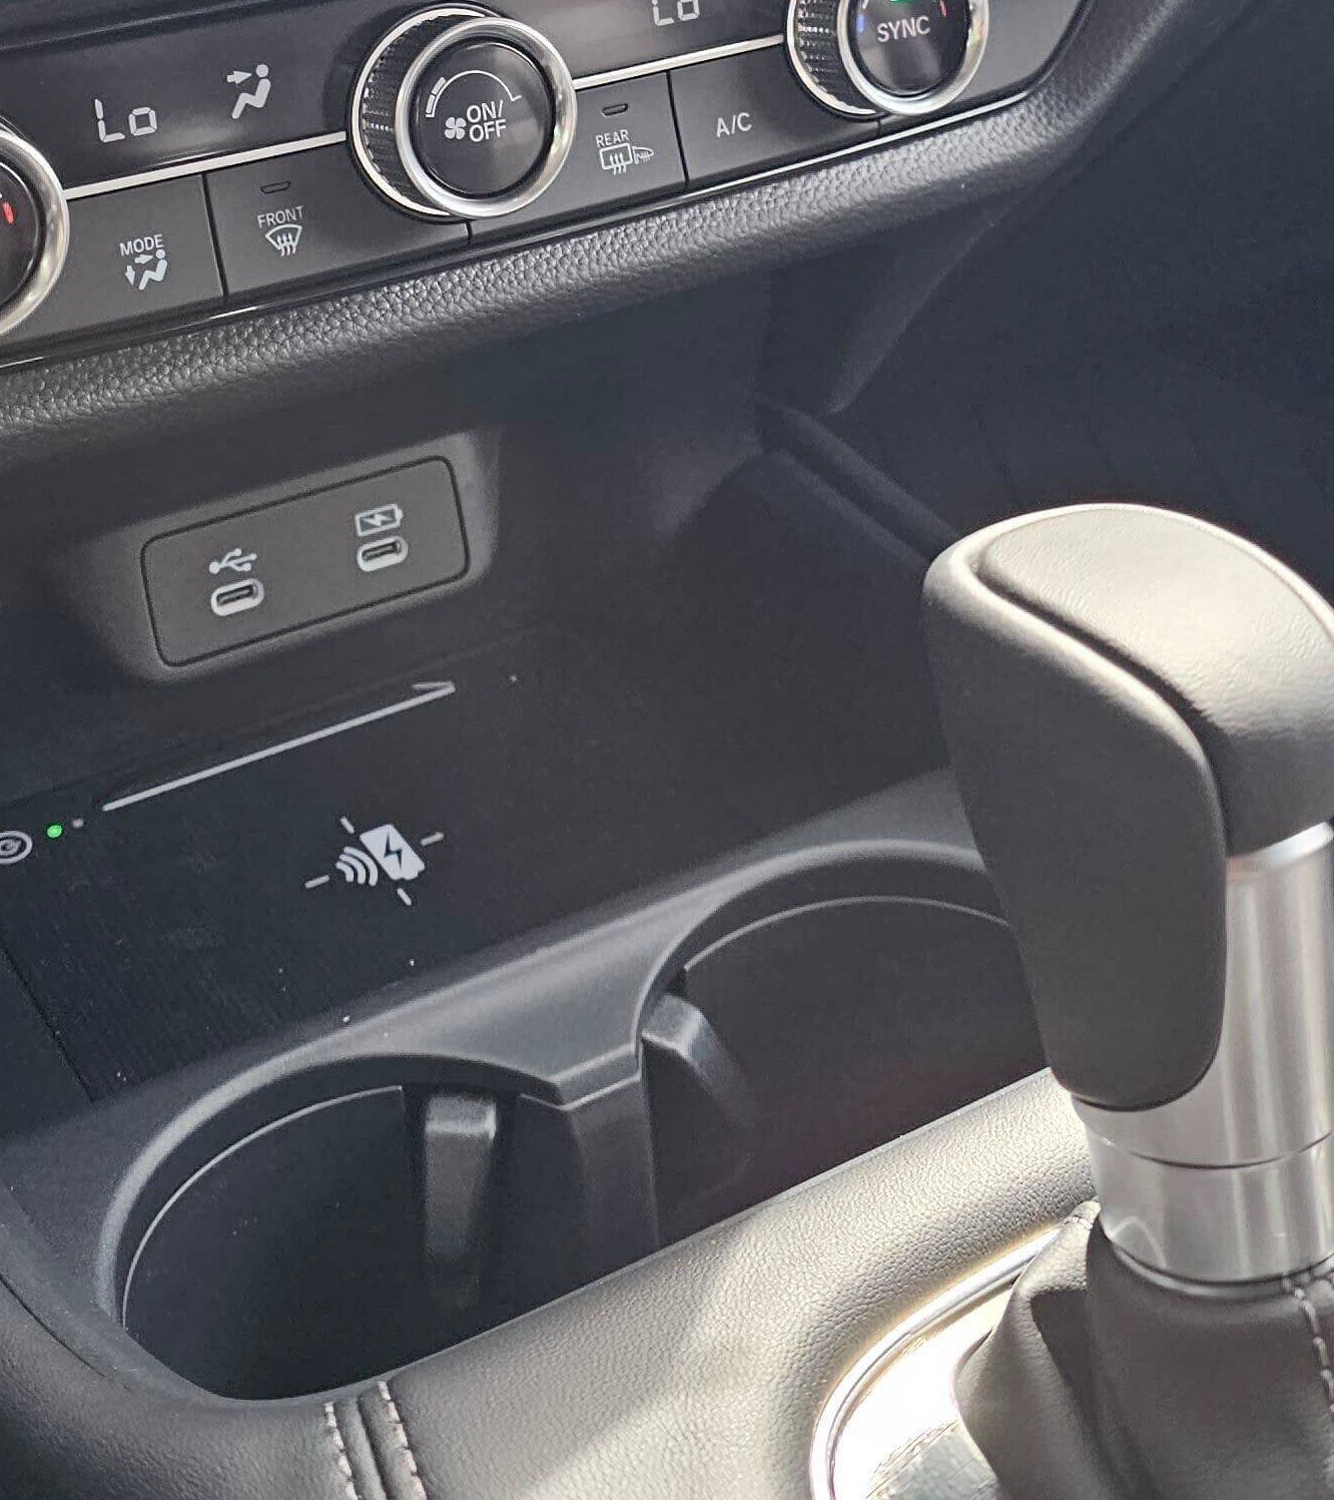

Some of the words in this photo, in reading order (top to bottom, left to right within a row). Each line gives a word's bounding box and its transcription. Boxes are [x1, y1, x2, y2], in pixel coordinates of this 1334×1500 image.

[876, 14, 932, 44] SYNC
[94, 98, 158, 143] Lo
[466, 99, 505, 124] ON/
[469, 118, 508, 144] OFF
[715, 111, 753, 138] A/C
[595, 128, 630, 147] REAR
[257, 204, 305, 229] FRONT
[119, 233, 165, 256] MODE
